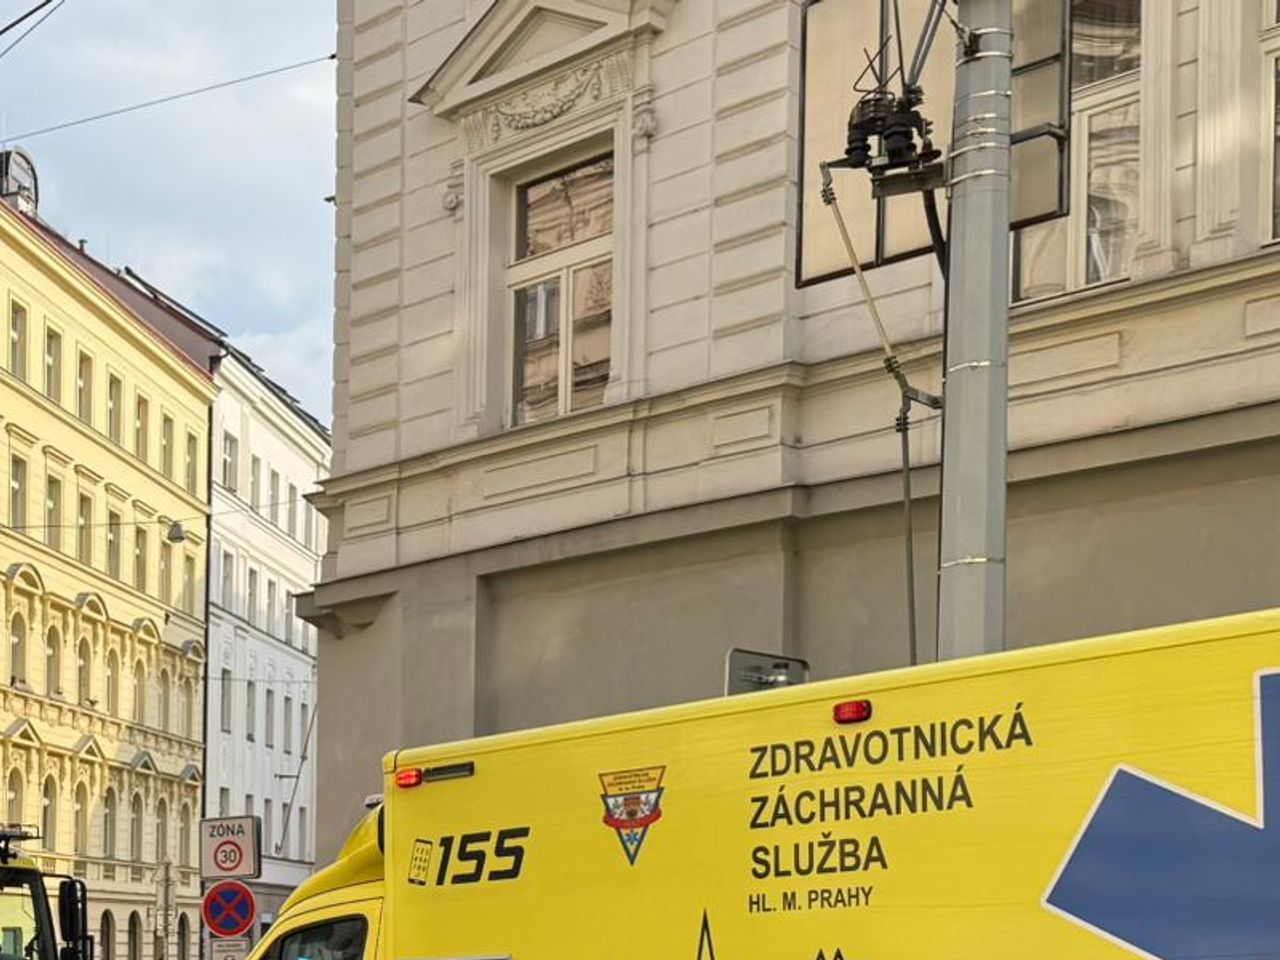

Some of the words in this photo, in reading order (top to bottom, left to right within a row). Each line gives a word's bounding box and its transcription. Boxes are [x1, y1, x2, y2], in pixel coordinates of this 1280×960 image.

[748, 702, 1033, 779] ZDRAVOTNICKÁ
[749, 764, 974, 829] ZÁCHRANNÁ
[209, 823, 245, 838] ZÓNA
[220, 849, 237, 863] 30
[435, 827, 530, 886] 155
[751, 831, 888, 879] SLUŽBA
[749, 893, 777, 913] HL.
[782, 891, 802, 911] M.
[807, 886, 873, 910] PRAHY
